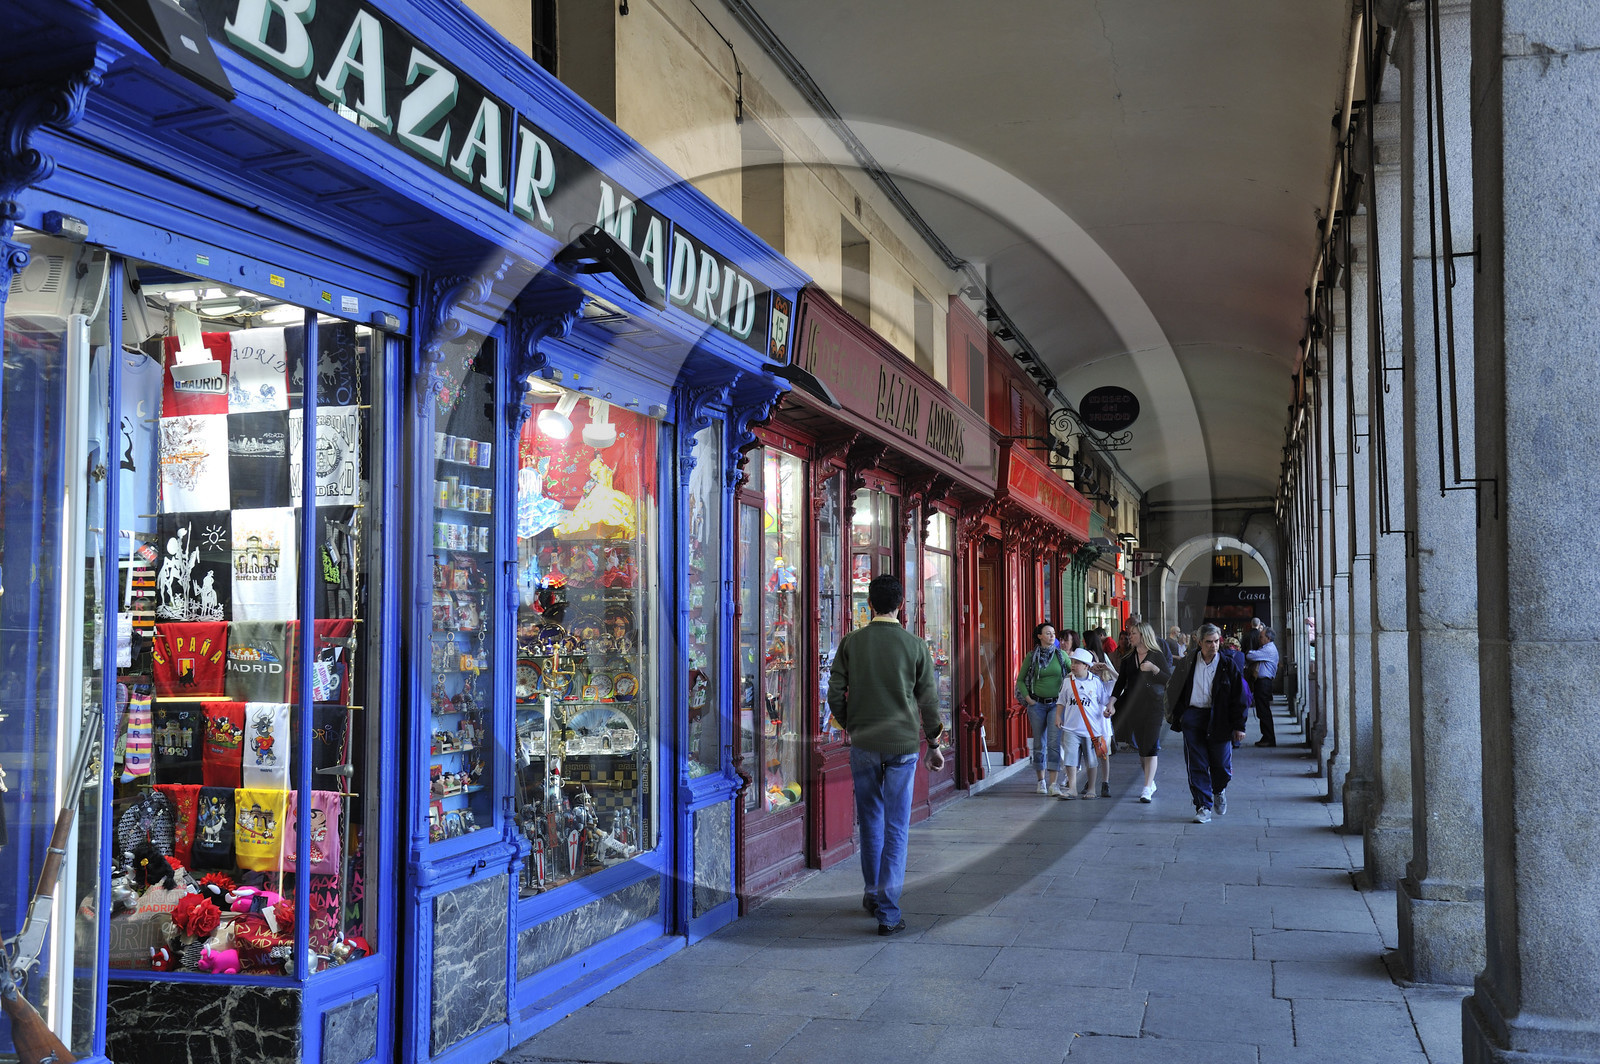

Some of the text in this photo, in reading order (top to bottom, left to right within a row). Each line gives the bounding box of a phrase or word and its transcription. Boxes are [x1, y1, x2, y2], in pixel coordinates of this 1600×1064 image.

[223, 0, 756, 341] BAZAR MADRID
[774, 314, 786, 342] 15
[806, 318, 820, 373] 16
[876, 364, 920, 439] BAZAR
[926, 399, 966, 465] ARRIBAS
[290, 461, 355, 498] MDRID
[1238, 590, 1267, 601] Casa
[153, 636, 223, 665] ESPAÑA
[131, 693, 144, 765] MADRID
